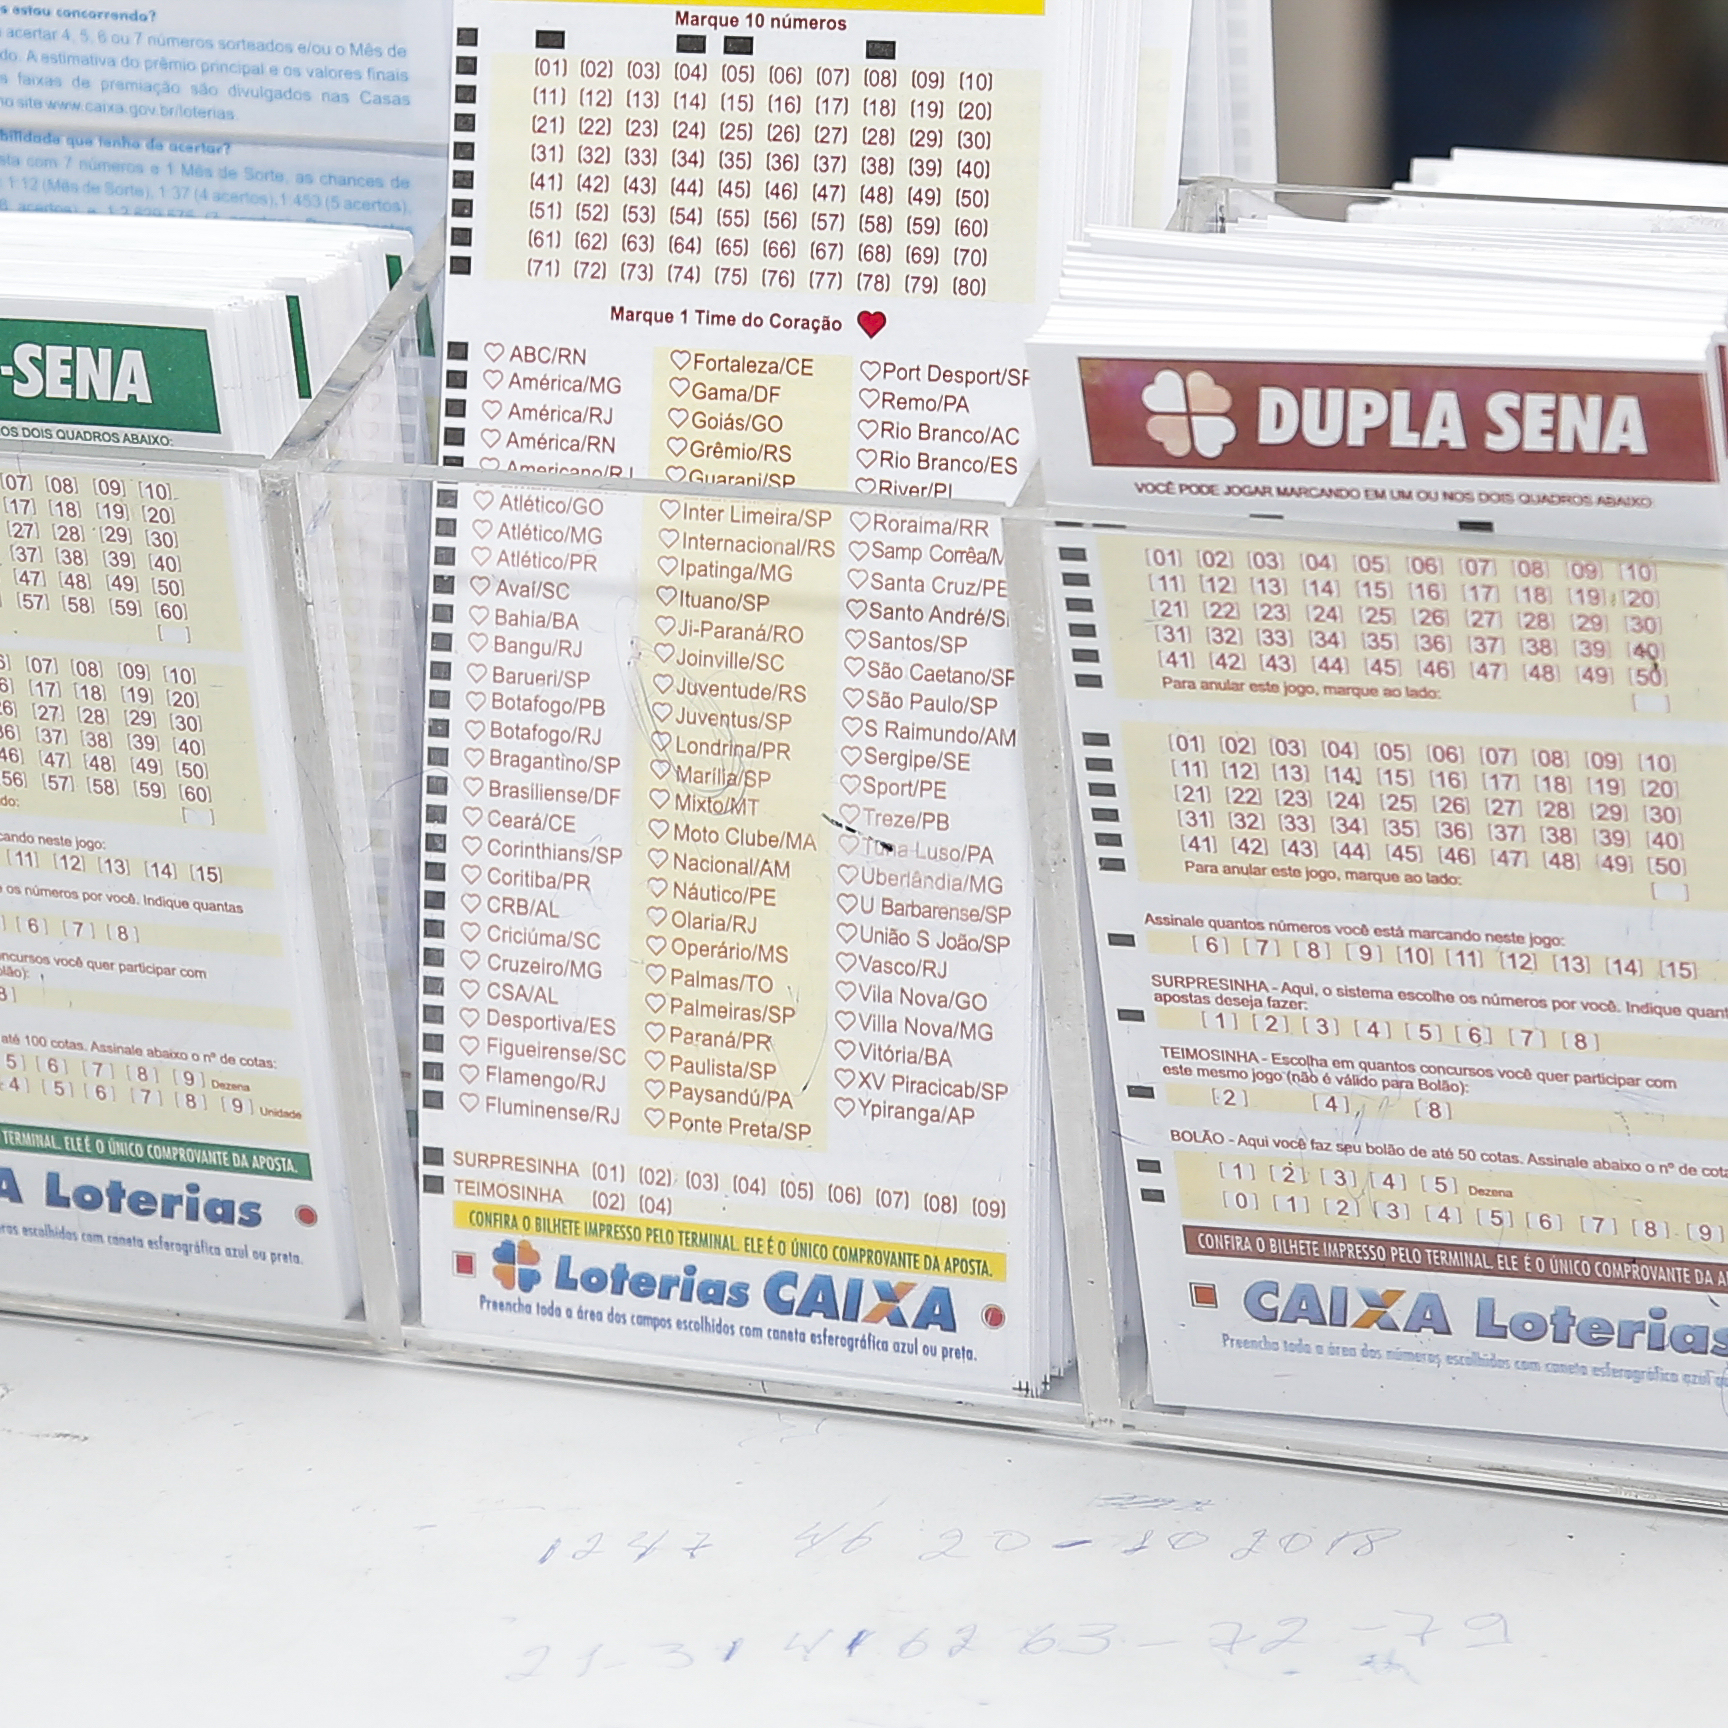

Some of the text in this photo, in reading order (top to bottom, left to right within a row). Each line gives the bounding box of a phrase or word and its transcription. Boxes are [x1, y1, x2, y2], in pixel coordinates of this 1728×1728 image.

[675, 10, 847, 31] Marque 10 números
[610, 305, 843, 335] Marque 1 Time do Coração
[509, 345, 587, 366] ABC/RN
[693, 352, 814, 377] Fortaleza/CE
[508, 372, 622, 395] América/MG
[691, 381, 782, 404] Gama/DF
[507, 402, 613, 425] América/RJ
[881, 391, 970, 414] Remo/PA
[691, 410, 784, 434] Goiás/GO
[1256, 388, 1649, 454] DUPLA SENA
[22, 426, 53, 439] DOIS
[56, 428, 120, 444] QUADROS
[123, 432, 172, 447] ABAIXO:
[505, 431, 616, 454] América/RN
[689, 439, 792, 463] Grêmio/RS
[499, 493, 604, 517] Atlético/GO
[1135, 480, 1175, 495] VOCÊ
[1180, 482, 1219, 496] PODE
[1224, 483, 1272, 498] JOGAR
[1277, 486, 1361, 501] MARCANDO
[1365, 489, 1386, 502] EM
[1391, 489, 1414, 502] UM
[1417, 490, 1439, 503] OU
[1443, 491, 1475, 504] NOS
[1479, 492, 1515, 505] DOIS
[1519, 493, 1593, 508] QUADROS
[497, 521, 603, 546] Atlético/MG
[682, 531, 836, 559] Internacional/RS
[496, 549, 598, 573] Atlético/PR
[495, 578, 570, 601] Avaí/SC
[494, 607, 580, 631] Bahia/BA
[493, 634, 583, 660] Bangu/RJ
[867, 630, 968, 655] Santos/SP
[492, 665, 591, 690] Barueri/SP
[491, 691, 606, 719] Botafogo/PB
[866, 689, 998, 716] São Paulo/SP
[490, 720, 602, 748] Botafogo/RJ
[489, 748, 621, 775] Bragantino/SP
[862, 775, 947, 800] Sport/PE
[671, 909, 757, 935] Olaria/RJ
[671, 937, 789, 964] Operário/MS
[858, 954, 947, 980] Vasco/RJ
[670, 967, 774, 994] Palmas/TO
[858, 982, 988, 1012] Vila Nova/GO
[670, 996, 796, 1025] Palmeiras/SP
[670, 1025, 774, 1052] Paraná/PR
[45, 1172, 263, 1228] Loterias
[469, 1210, 993, 1277] CONFIRA O BILHETE IMPRESSO PELO TERMINAL. ELE É O ÚNICO COMPROVANTE DA APOSTA.
[1197, 1233, 1252, 1253] CONFIRA
[1256, 1238, 1265, 1254] O
[1270, 1238, 1319, 1259] BILHETE
[1323, 1242, 1386, 1264] IMPRESSO
[1391, 1246, 1422, 1265] PELO
[1426, 1249, 1492, 1270] TERMINAL.
[1497, 1253, 1519, 1272] ELE
[1523, 1252, 1533, 1272] É
[1537, 1256, 1546, 1274] O
[1550, 1255, 1590, 1278] ÚNICO
[1594, 1260, 1690, 1284] COMPROVANTE
[1695, 1268, 1714, 1286] DA
[555, 1254, 957, 1332] Loterias CAIXA
[1243, 1280, 1452, 1335] CAIXA
